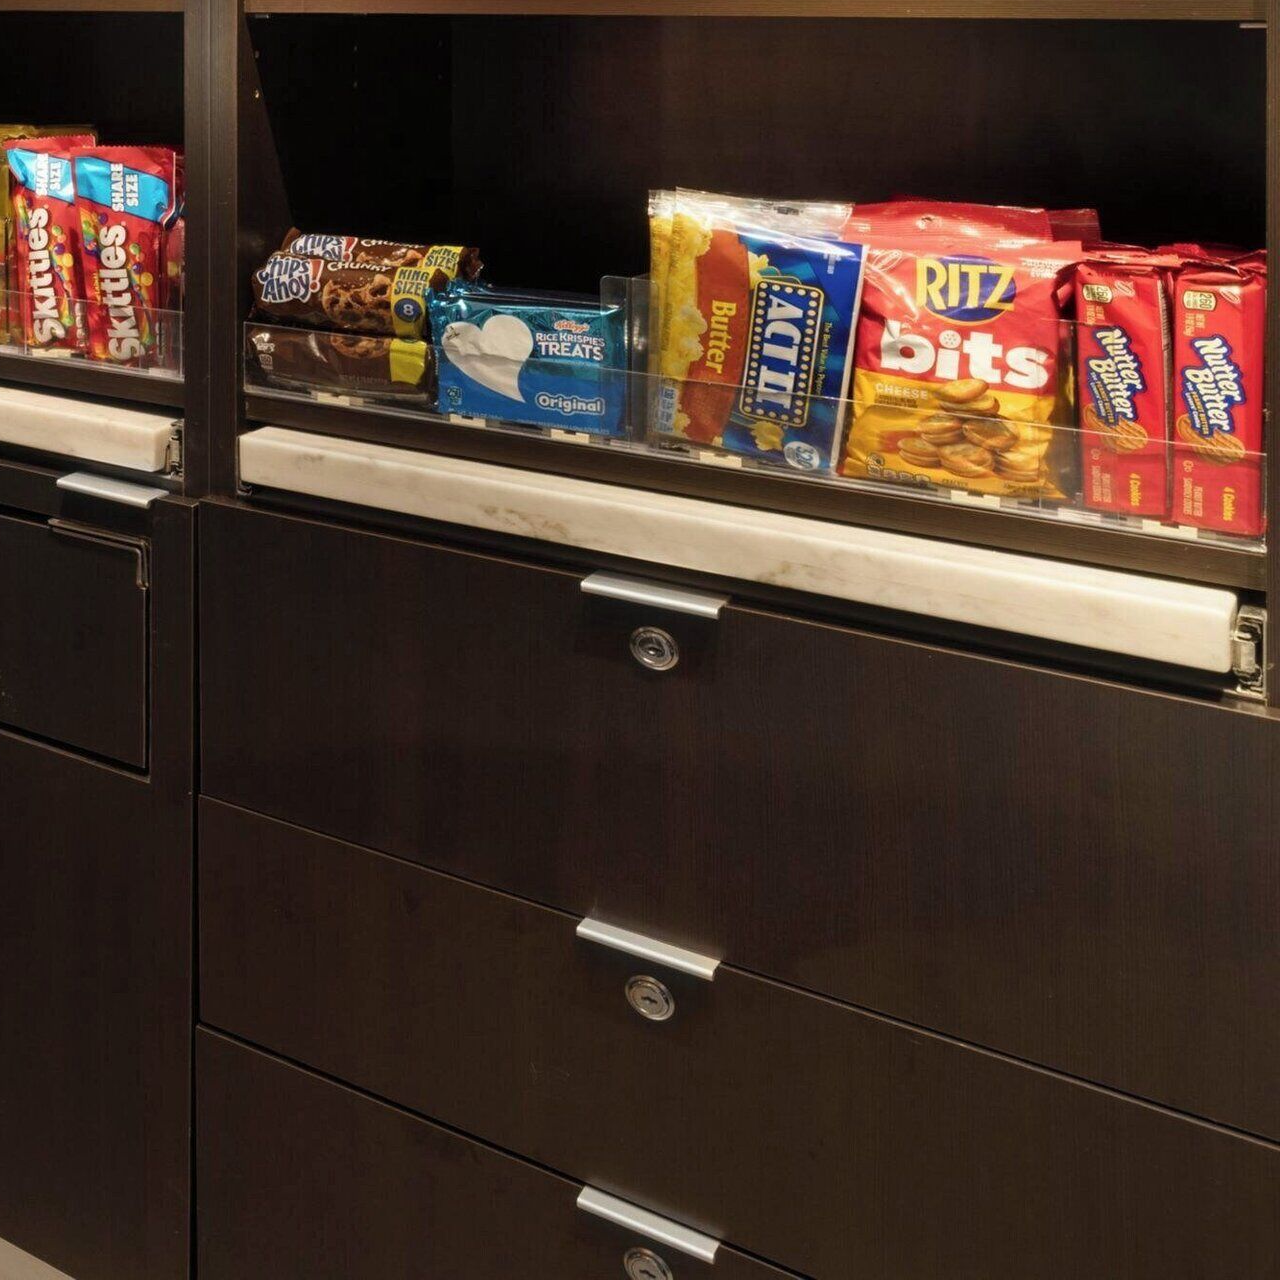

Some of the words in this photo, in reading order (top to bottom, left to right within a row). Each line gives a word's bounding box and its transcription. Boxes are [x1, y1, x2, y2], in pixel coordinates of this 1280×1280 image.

[35, 153, 49, 197] SHARE
[50, 162, 62, 190] SIZE
[111, 163, 123, 212] SHARE
[125, 174, 139, 207] SIZE
[28, 207, 66, 344] Skittles
[258, 257, 310, 282] Chips
[327, 261, 393, 273] CHUNKY
[398, 269, 430, 282] KING
[425, 256, 458, 270] SIZE!
[99, 223, 144, 361] Skittles
[394, 280, 428, 296] SIZE!
[915, 257, 1017, 311] RITZ
[402, 304, 414, 316] 8
[1199, 294, 1213, 309] 260
[536, 333, 559, 342] RICE
[559, 332, 606, 347] KRISPIES
[705, 300, 737, 375] Butter
[760, 295, 804, 366] ACT
[538, 342, 605, 362] TREATS
[880, 320, 1050, 391] bits
[1095, 327, 1143, 391] Nutter
[1194, 336, 1243, 404] Nutter
[756, 365, 796, 410] II
[874, 382, 929, 400] CHEESE
[1088, 358, 1134, 420] Butter
[1184, 368, 1232, 431] Butter
[537, 395, 603, 412] Original
[1129, 479, 1141, 506] Cookies
[1222, 493, 1235, 521] Cookies
